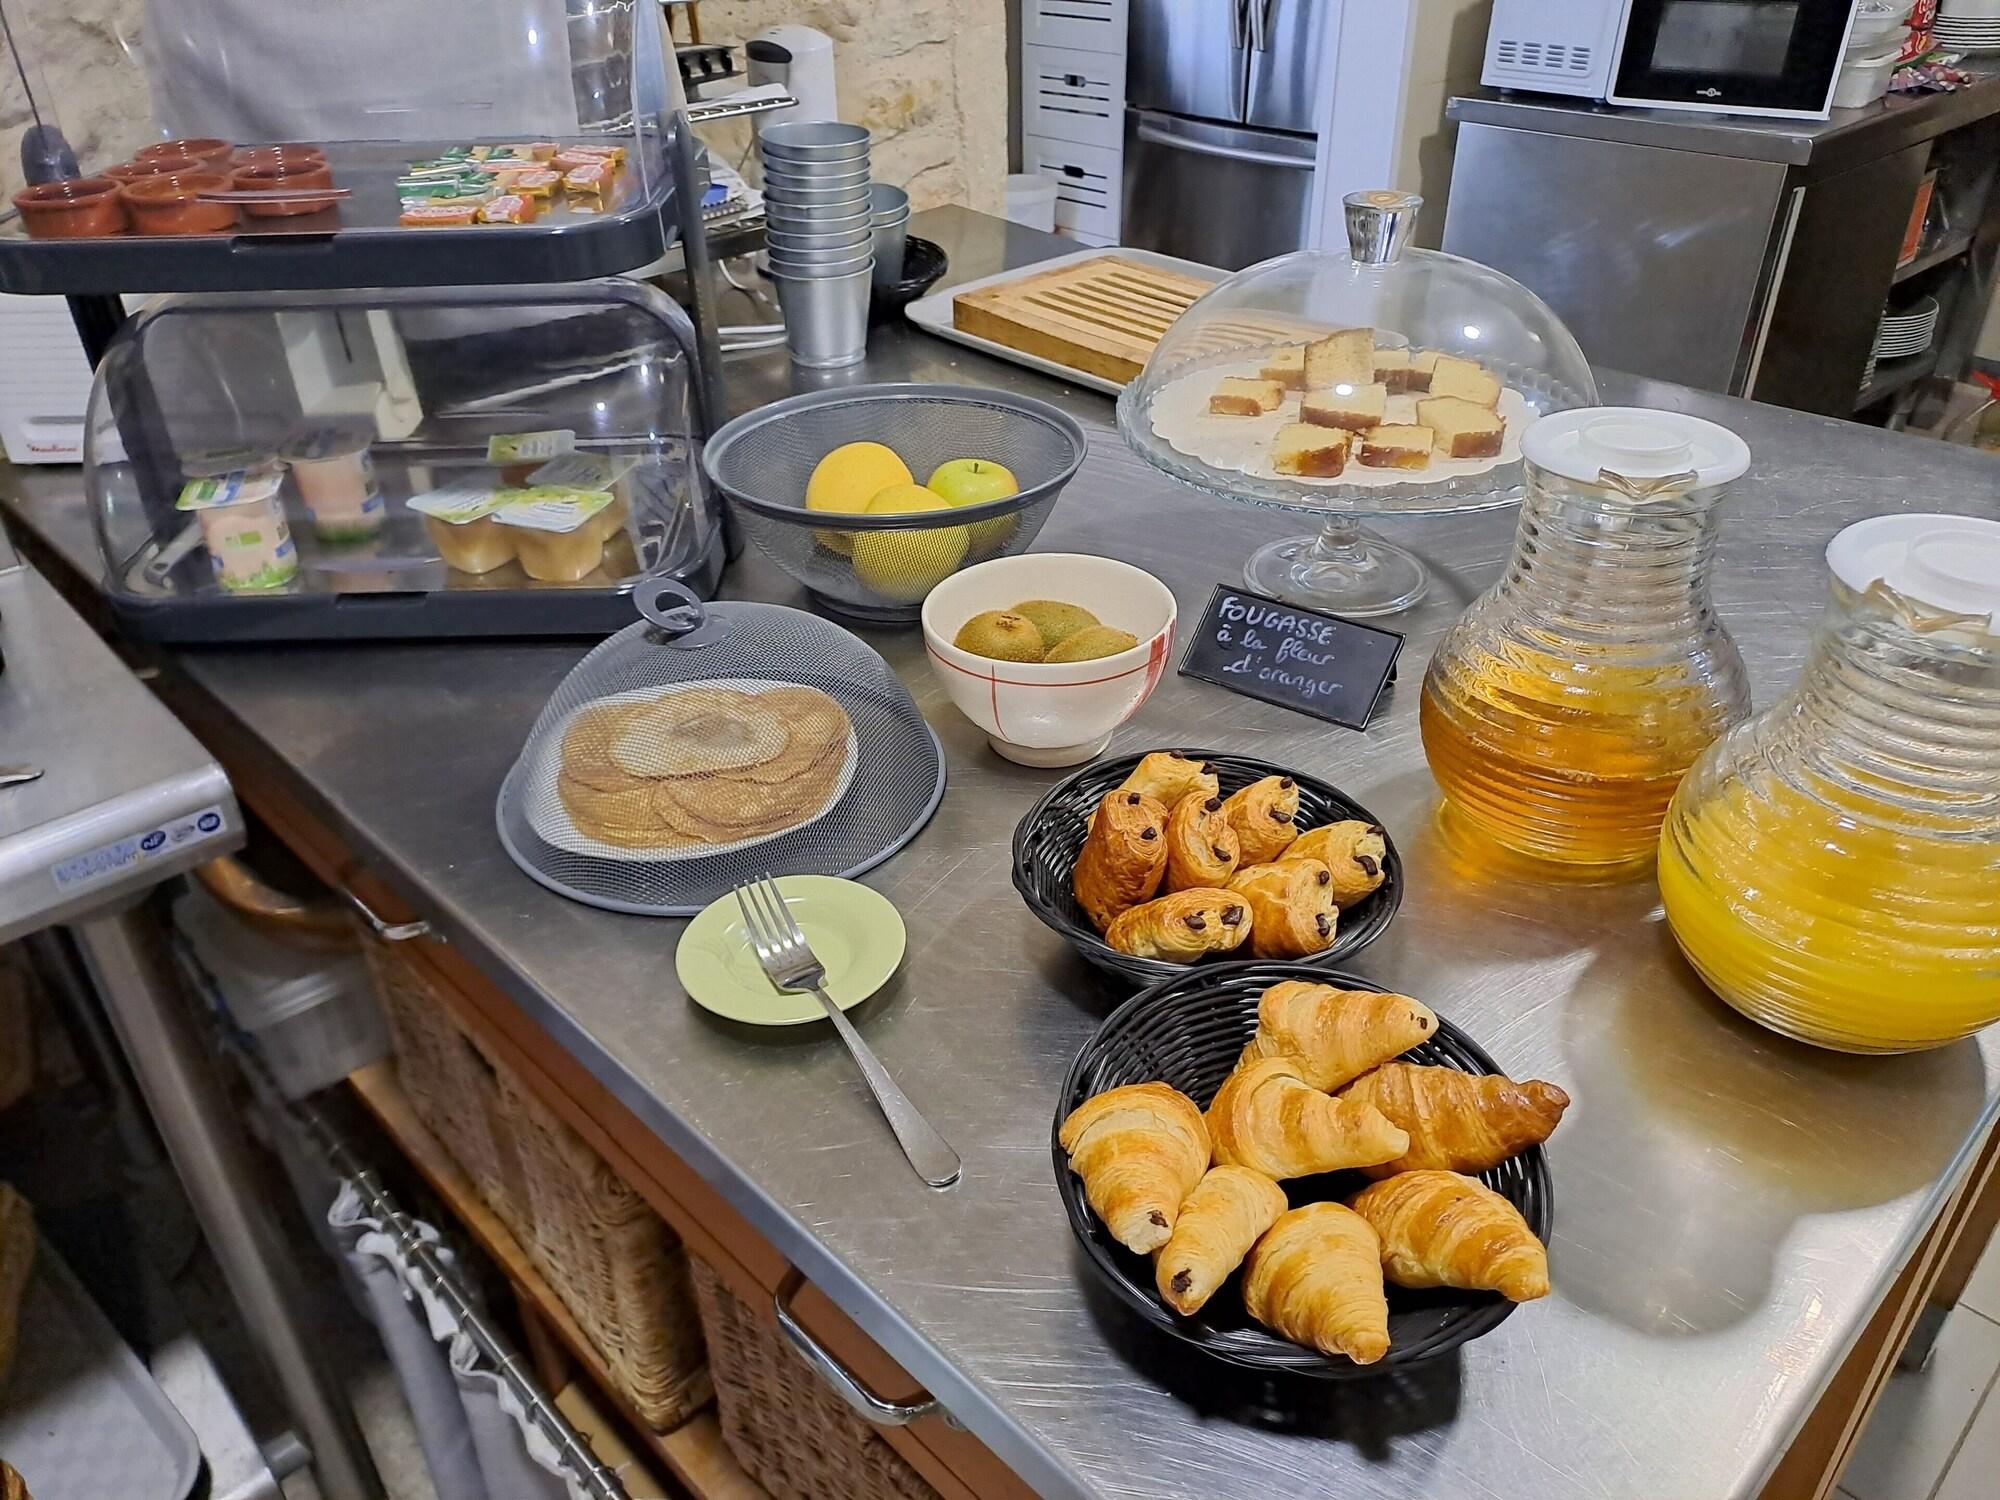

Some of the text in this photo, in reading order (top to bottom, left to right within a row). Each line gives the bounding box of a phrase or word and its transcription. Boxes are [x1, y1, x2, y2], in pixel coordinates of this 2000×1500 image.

[1218, 597, 1336, 645] FOUGASSE
[1240, 629, 1267, 650] la
[1275, 637, 1335, 665] fleur
